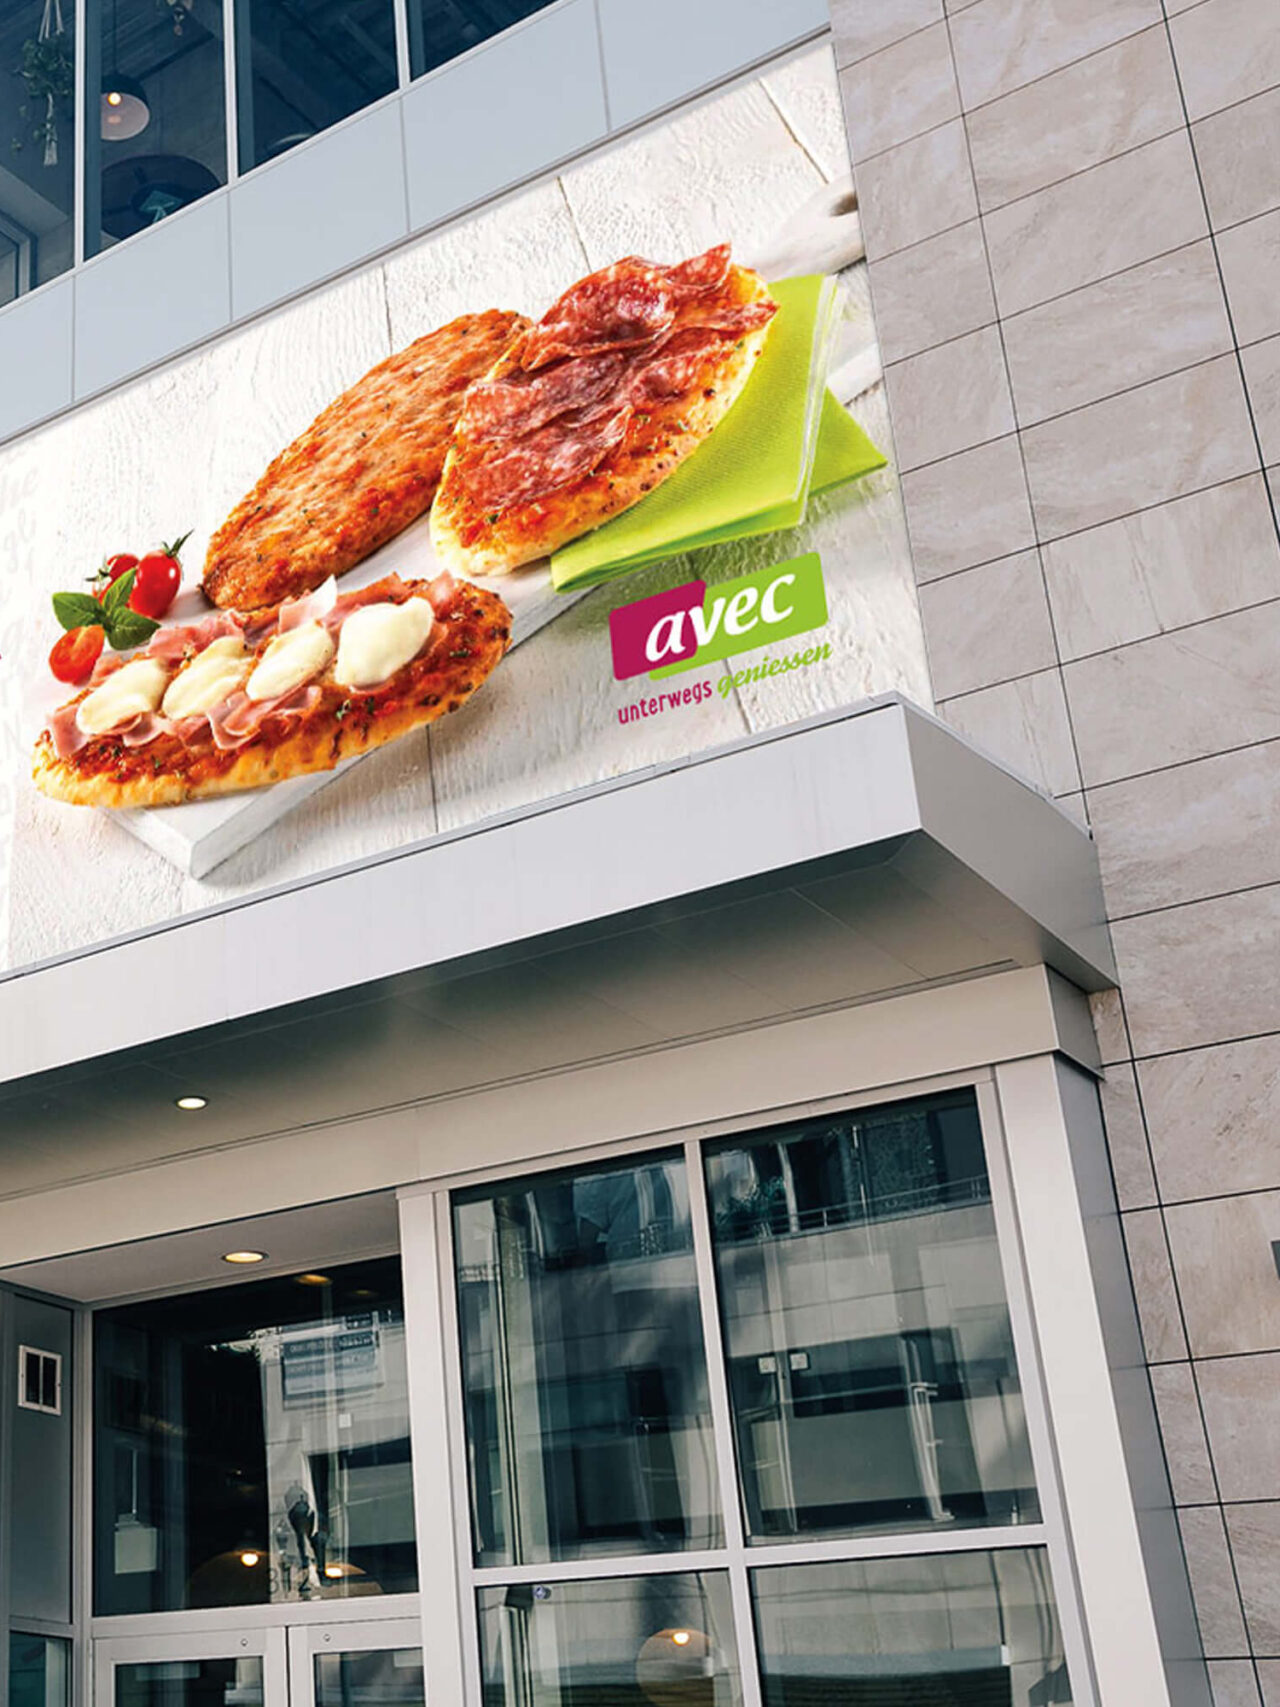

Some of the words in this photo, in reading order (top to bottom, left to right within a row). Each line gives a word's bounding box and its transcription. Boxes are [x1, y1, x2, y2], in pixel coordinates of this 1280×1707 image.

[646, 574, 795, 662] avec
[618, 680, 713, 725] unterwegs
[717, 641, 833, 699] geniessen
